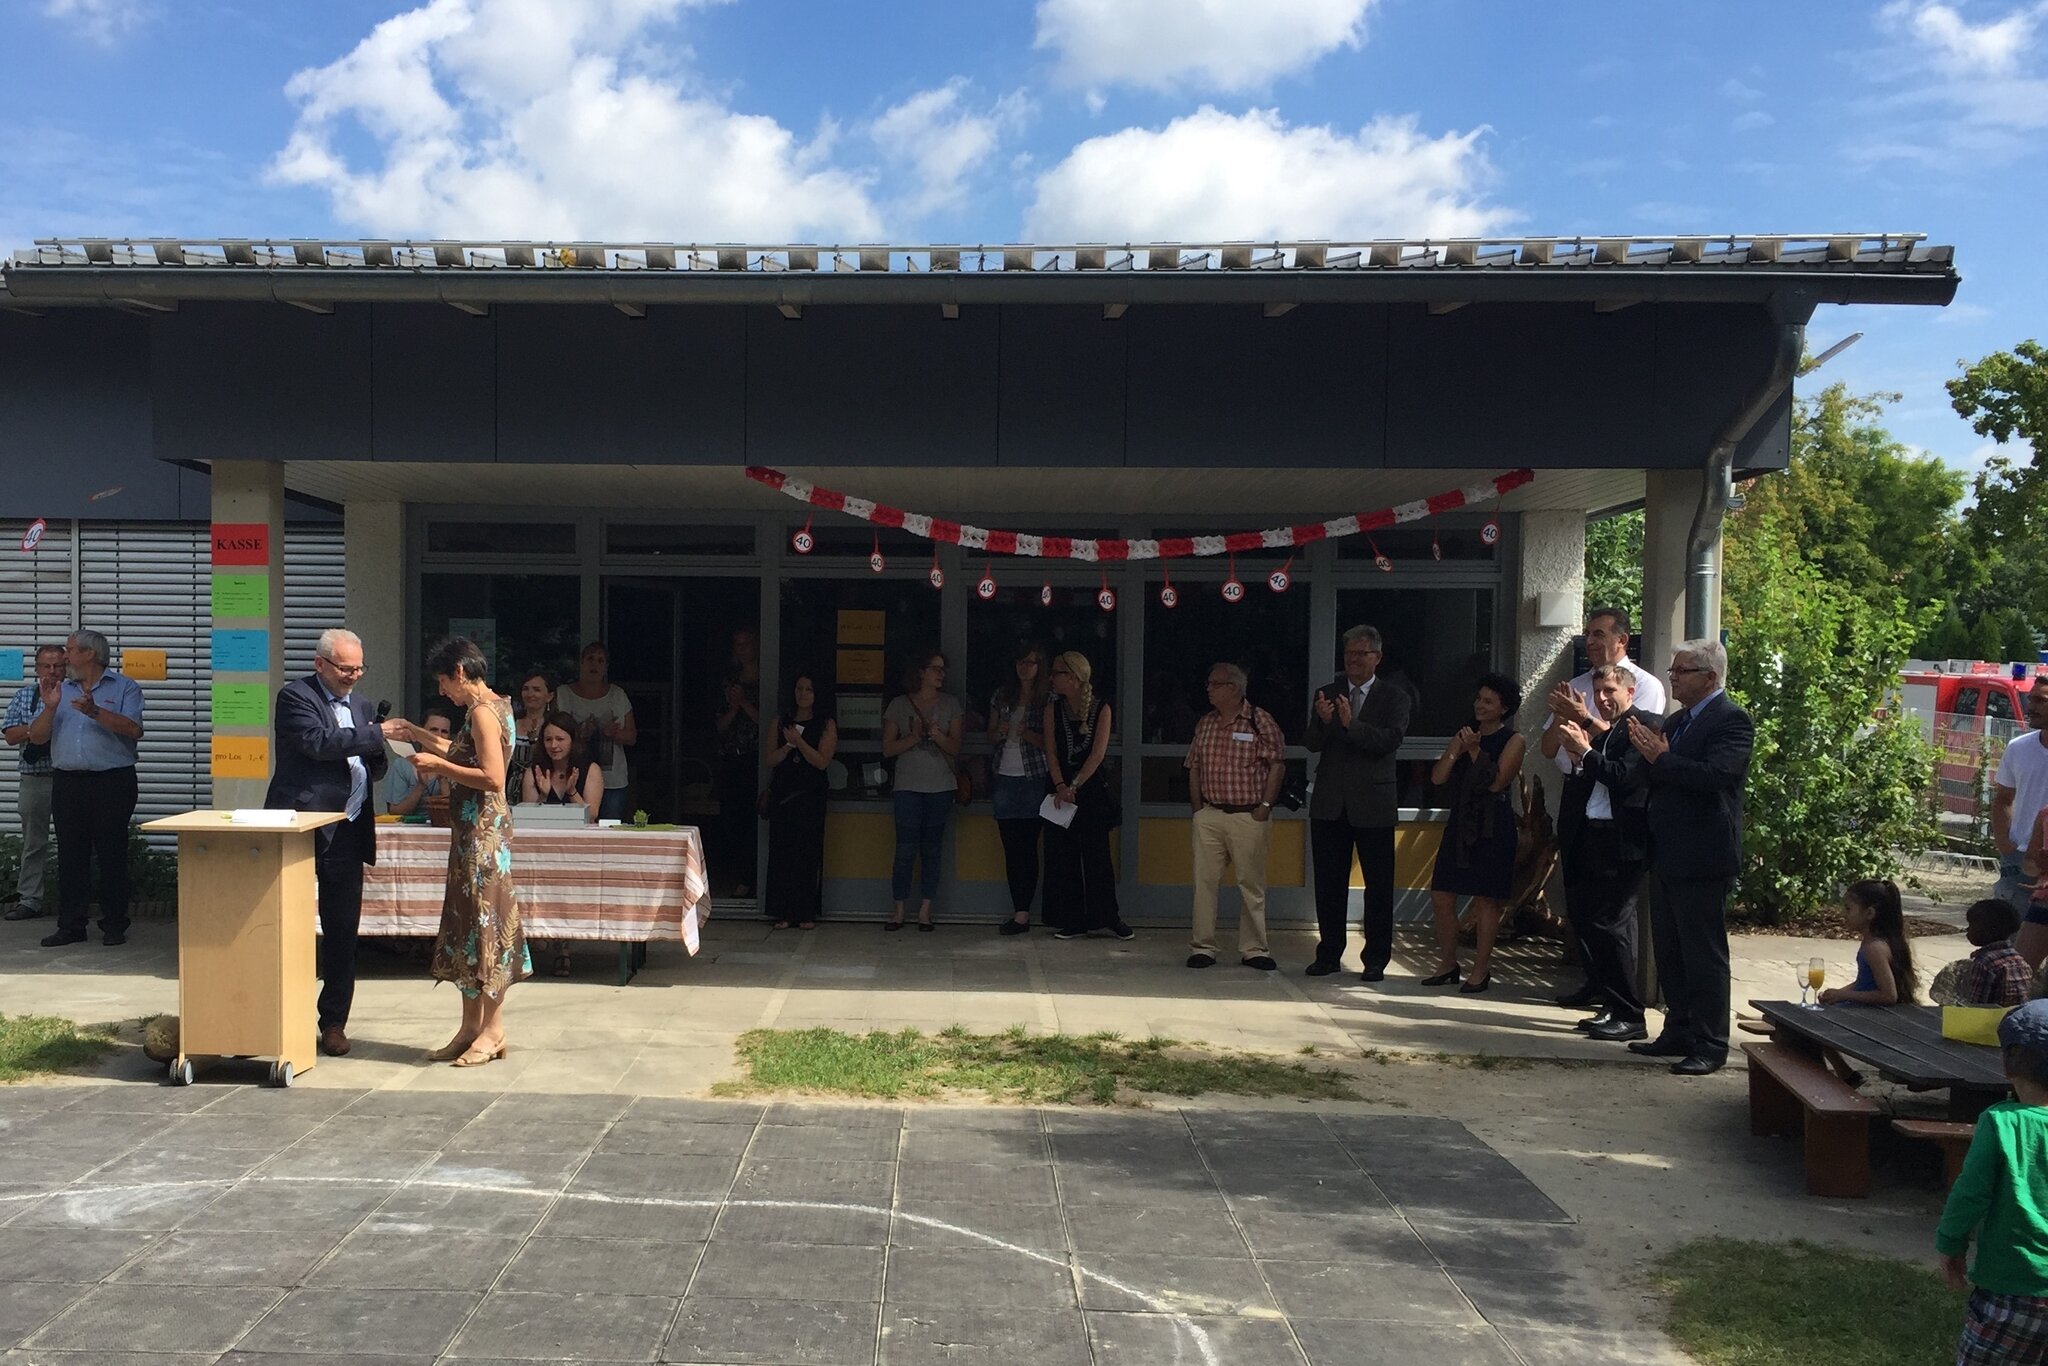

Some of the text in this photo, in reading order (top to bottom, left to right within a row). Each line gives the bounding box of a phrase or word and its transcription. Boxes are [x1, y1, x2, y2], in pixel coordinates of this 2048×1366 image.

[24, 530, 42, 543] 40
[1483, 528, 1498, 539] 40
[216, 538, 263, 550] KASSE
[795, 536, 811, 549] 40
[871, 558, 882, 568] 40
[1377, 560, 1391, 569] 40
[930, 573, 942, 584] 40
[1270, 575, 1287, 588] 40
[980, 583, 994, 593] 40
[1223, 587, 1241, 597] 40
[1099, 595, 1113, 605] 40
[1162, 592, 1175, 603] 40
[215, 754, 227, 762] pro
[228, 753, 242, 761] Los
